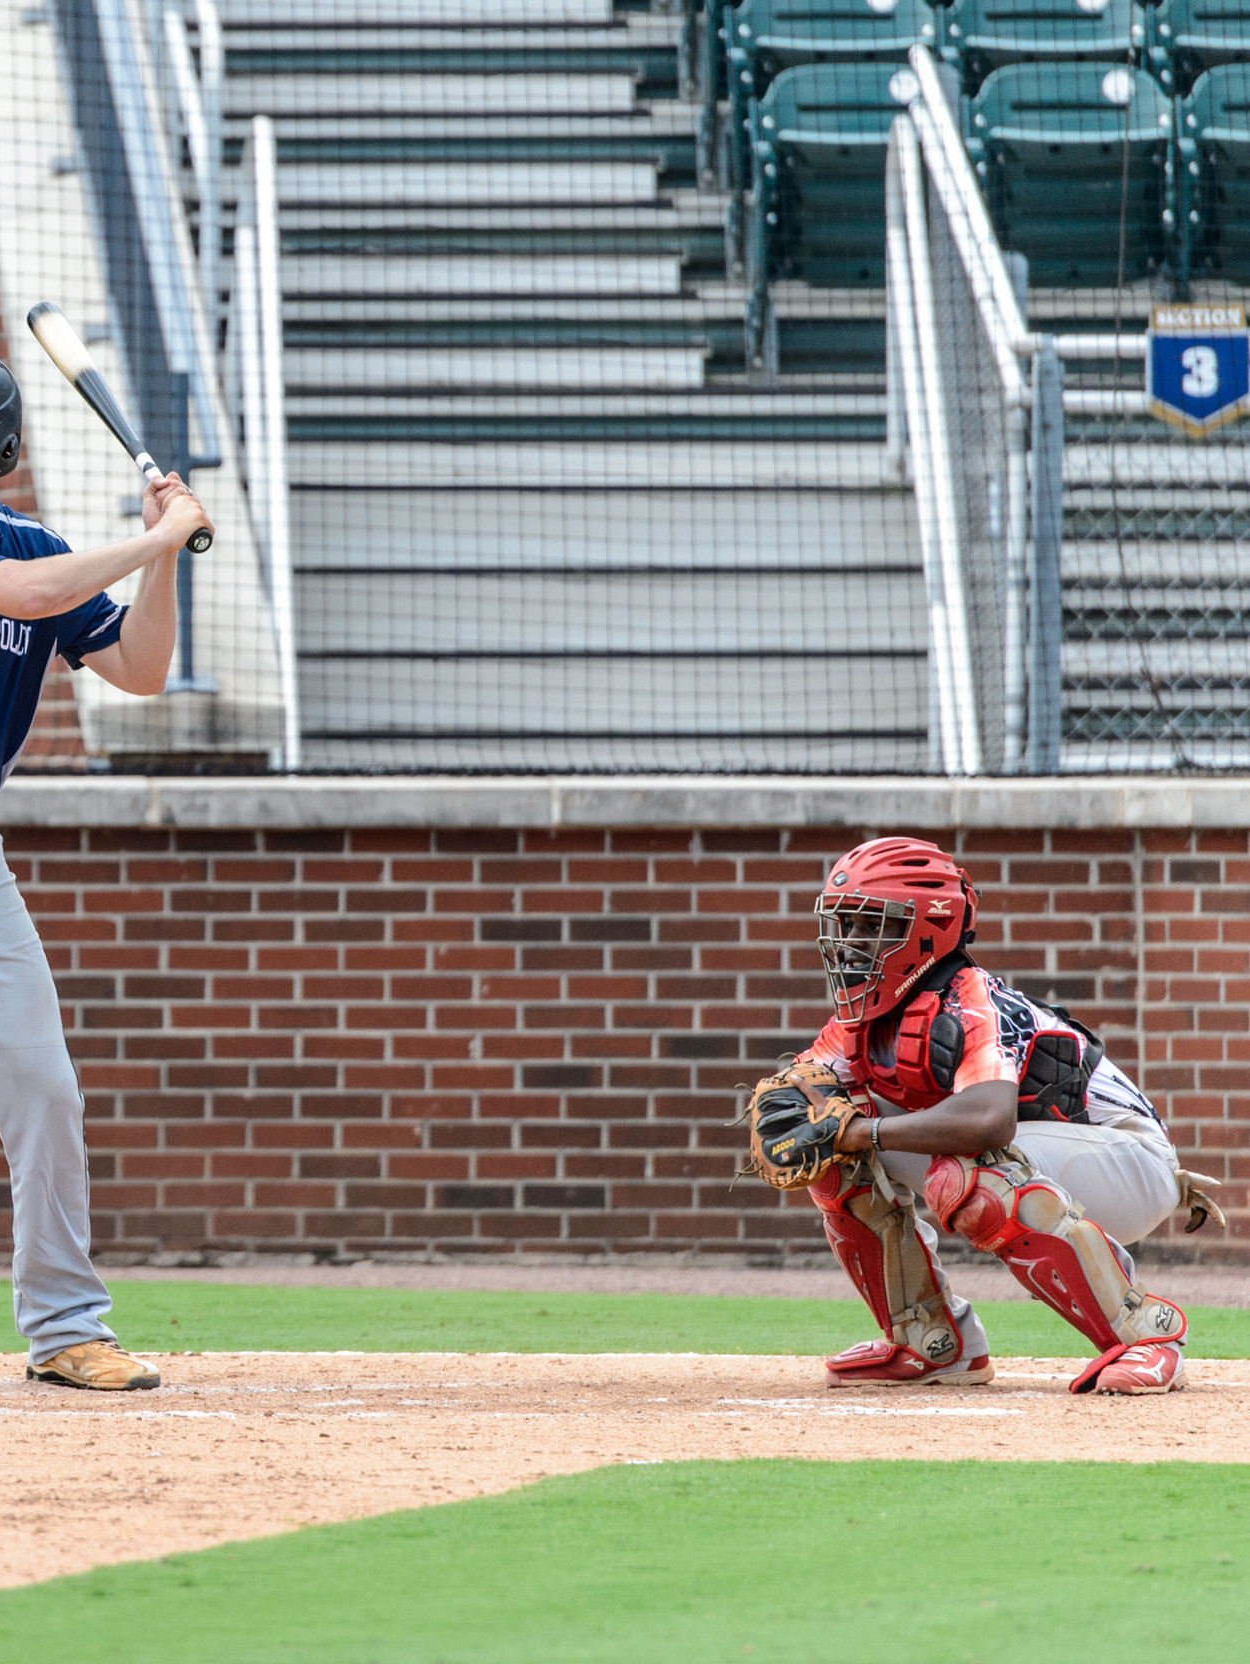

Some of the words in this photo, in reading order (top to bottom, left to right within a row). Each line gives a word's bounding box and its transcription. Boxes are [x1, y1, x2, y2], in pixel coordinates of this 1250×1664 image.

[1182, 346, 1219, 398] 3
[894, 956, 936, 998] SAMURAI
[772, 1138, 795, 1156] A2000
